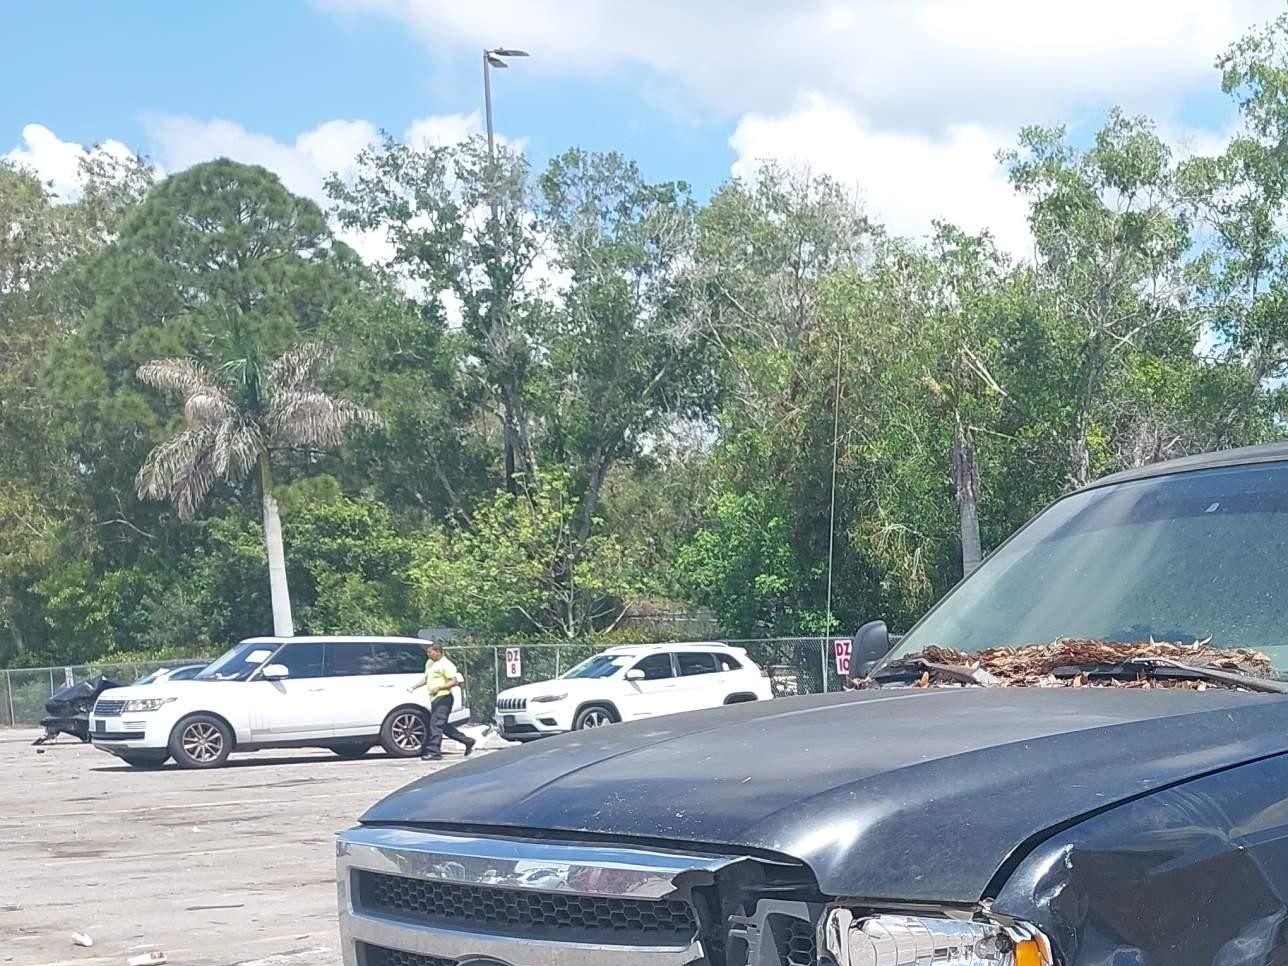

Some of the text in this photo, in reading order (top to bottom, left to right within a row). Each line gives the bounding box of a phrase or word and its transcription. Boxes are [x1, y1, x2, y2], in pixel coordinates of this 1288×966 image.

[836, 642, 850, 656] DZ
[507, 650, 518, 662] DZ
[511, 663, 516, 674] 8
[839, 657, 850, 671] 10
